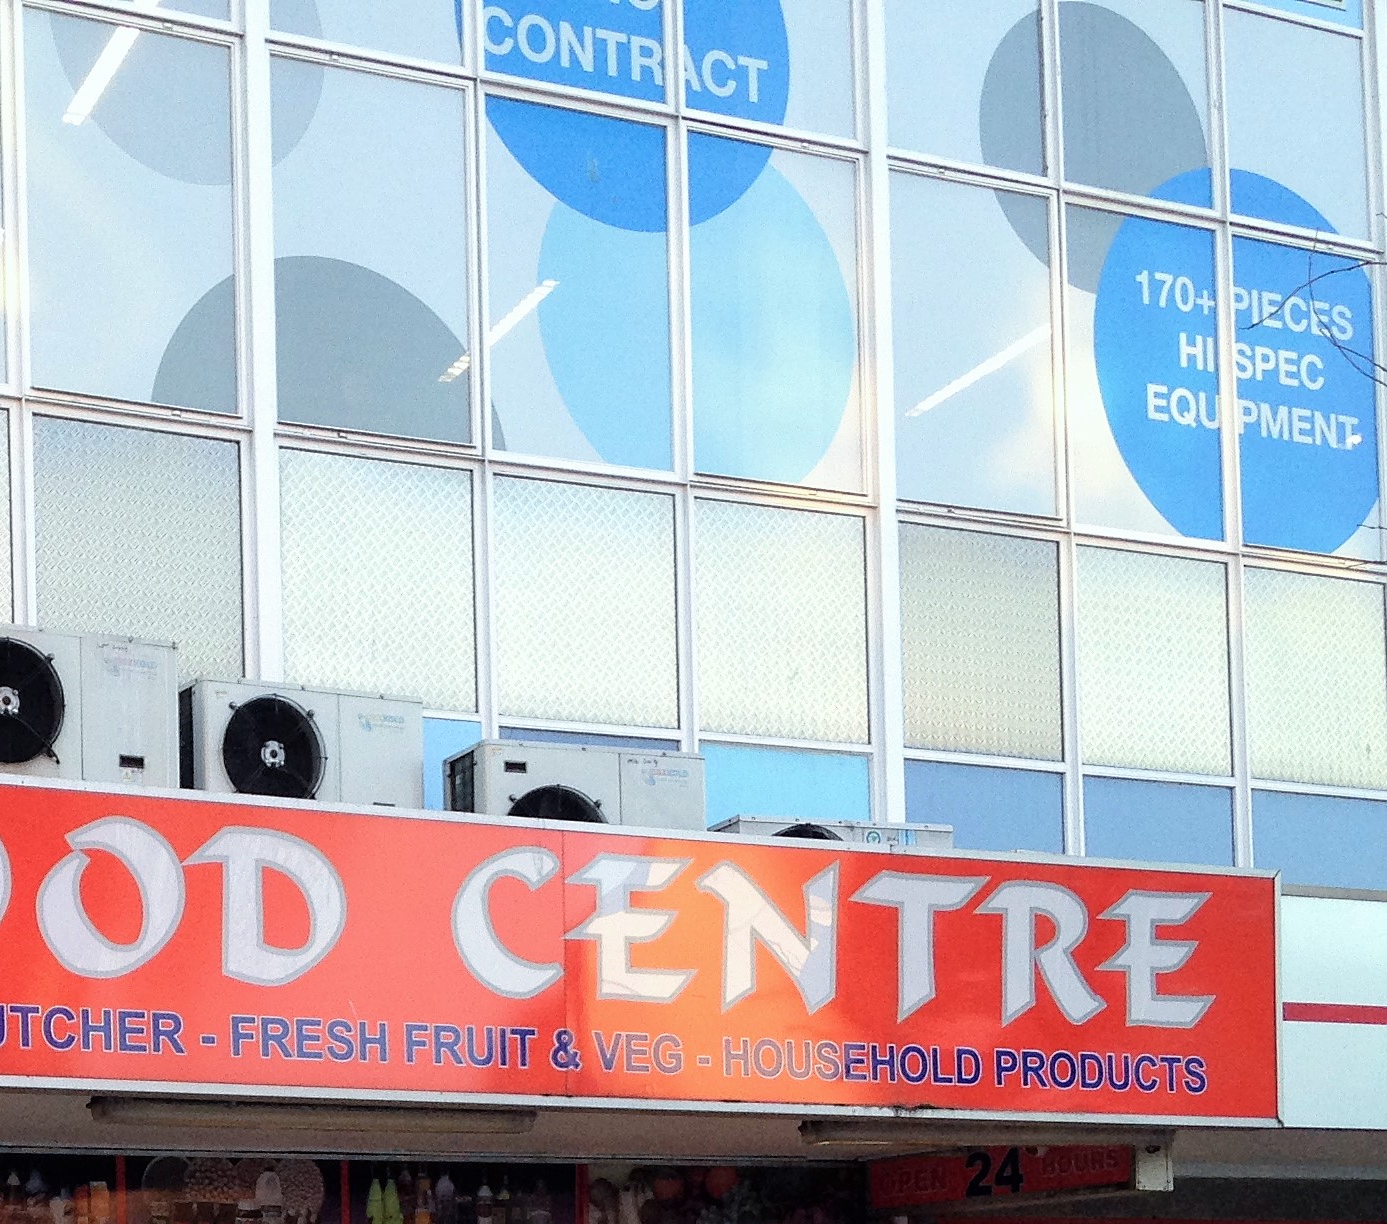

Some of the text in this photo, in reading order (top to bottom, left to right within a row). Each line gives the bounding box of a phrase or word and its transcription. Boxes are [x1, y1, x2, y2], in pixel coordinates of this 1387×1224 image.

[484, 7, 768, 103] CONTRACT
[1135, 269, 1353, 340] 170+ PIECES
[1234, 343, 1324, 390] SPEC
[1146, 384, 1358, 450] EQUPMENT
[450, 845, 1216, 1028] CENTRE
[230, 1013, 391, 1066] FRESH
[404, 1021, 538, 1071] FRUIT
[551, 1028, 582, 1072] &
[594, 1031, 685, 1076] VEG
[723, 1038, 981, 1087] HOUSEHOLD
[994, 1050, 1208, 1096] PRODUCTS
[965, 1147, 1023, 1197] 24
